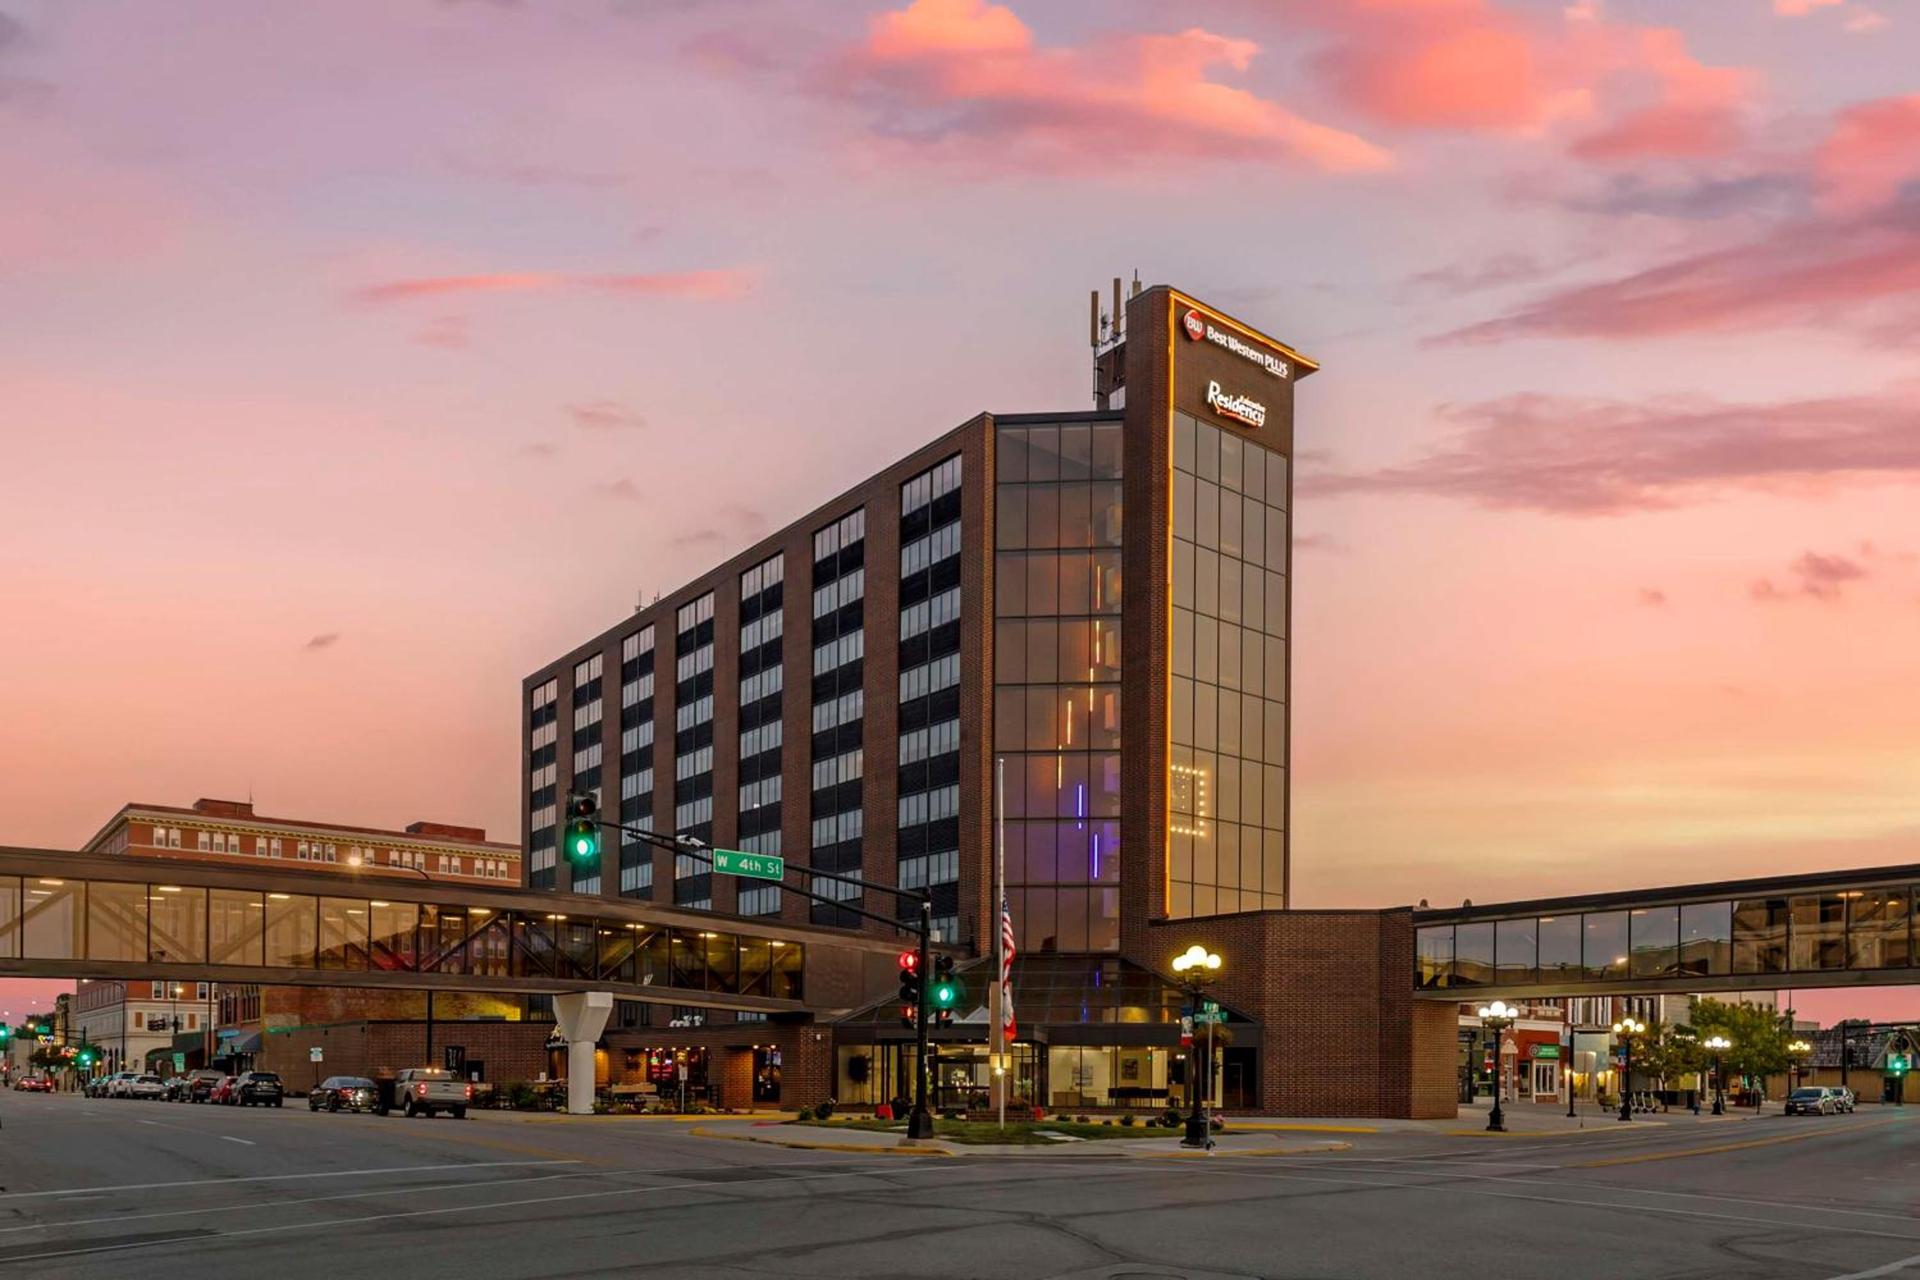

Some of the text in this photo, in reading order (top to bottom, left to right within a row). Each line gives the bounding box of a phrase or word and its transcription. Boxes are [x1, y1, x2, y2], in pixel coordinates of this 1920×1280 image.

[1187, 316, 1202, 333] BW
[1207, 325, 1288, 376] Best Western PLUS
[1207, 380, 1265, 427] Residency
[717, 855, 780, 875] W 4th St
